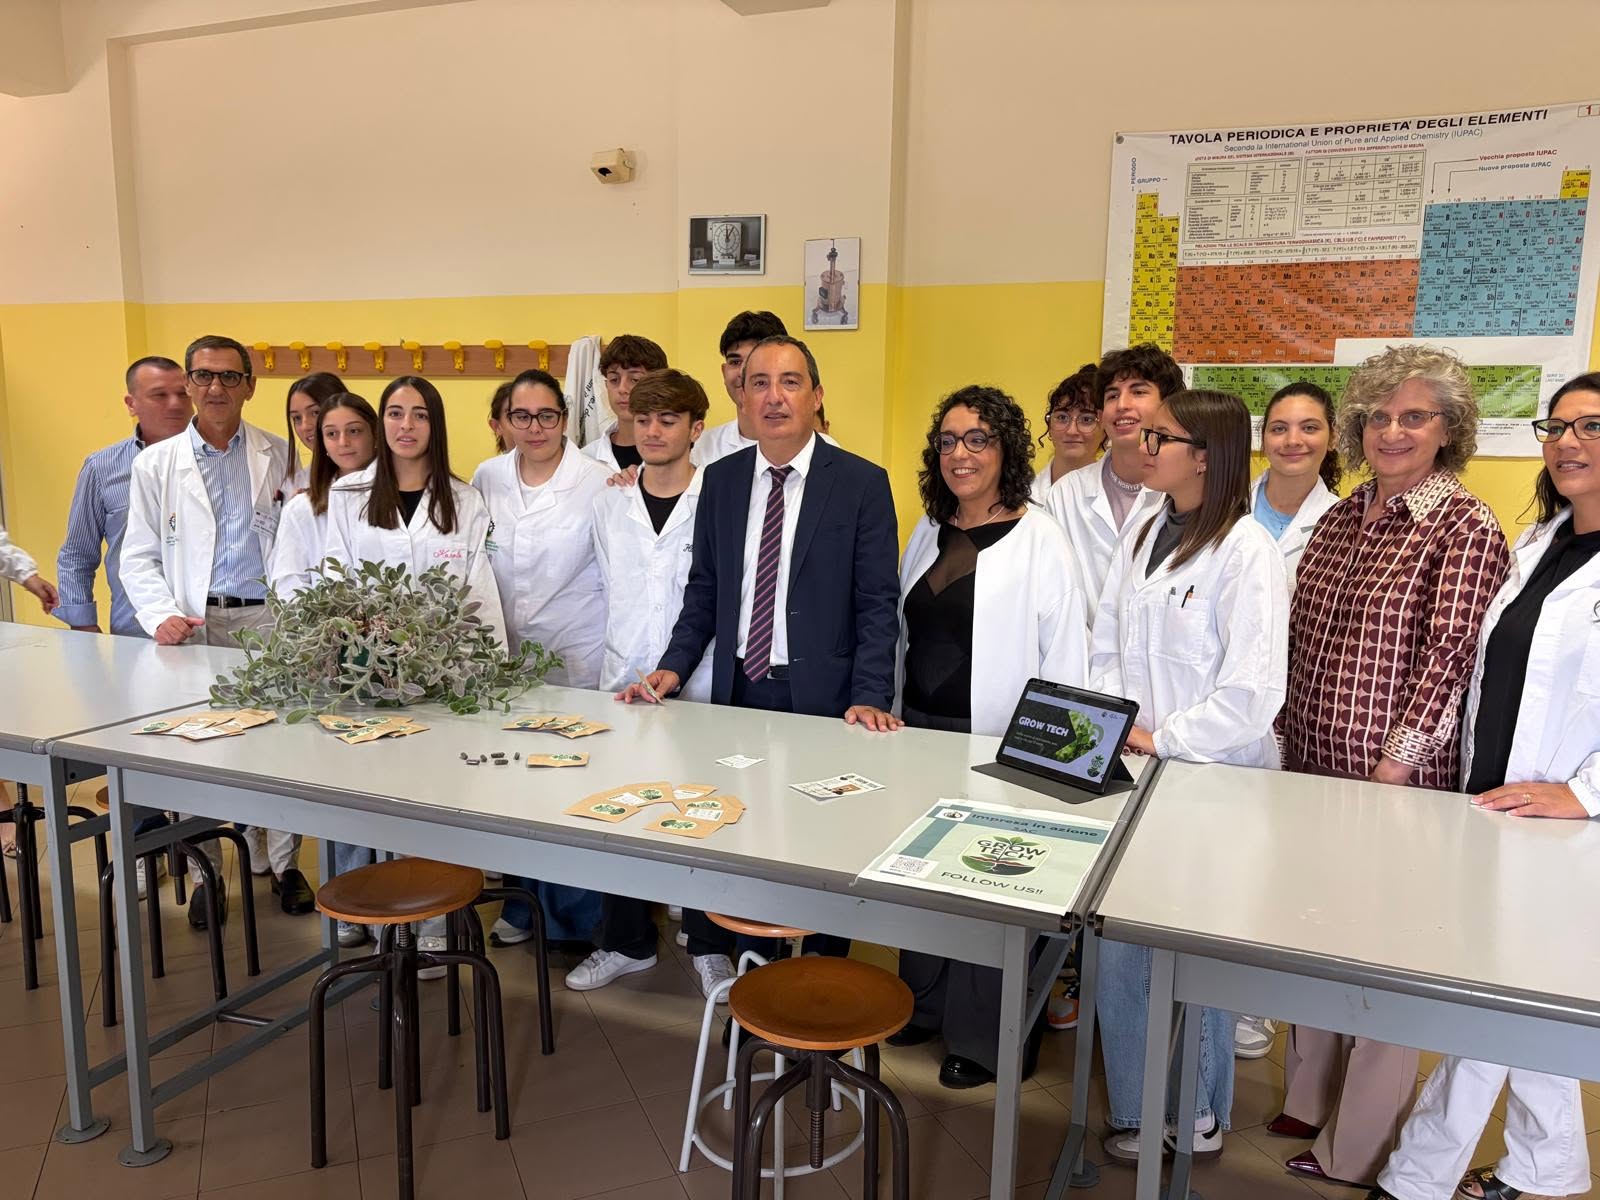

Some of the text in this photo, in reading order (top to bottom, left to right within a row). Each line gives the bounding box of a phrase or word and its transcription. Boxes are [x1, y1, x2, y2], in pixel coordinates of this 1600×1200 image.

[1586, 105, 1592, 114] 1
[1169, 109, 1548, 145] TAVOLA PERIODICA E PROPRIETA' DEGLI ELEMENTI
[1266, 140, 1310, 150] International
[1311, 138, 1332, 146] Union
[1335, 137, 1342, 145] of
[1345, 136, 1362, 144] Pure
[1364, 135, 1378, 143] and
[1380, 133, 1408, 144] Applied
[1410, 132, 1449, 141] Chemistry
[1452, 128, 1483, 139] (IUPAC)
[1018, 716, 1070, 737] GROW TECH
[972, 814, 1028, 826] Impresa
[1050, 826, 1098, 837] azione
[978, 840, 1047, 856] GROW
[980, 846, 1034, 860] TECH
[941, 871, 1044, 895] FOLLOW US!!
